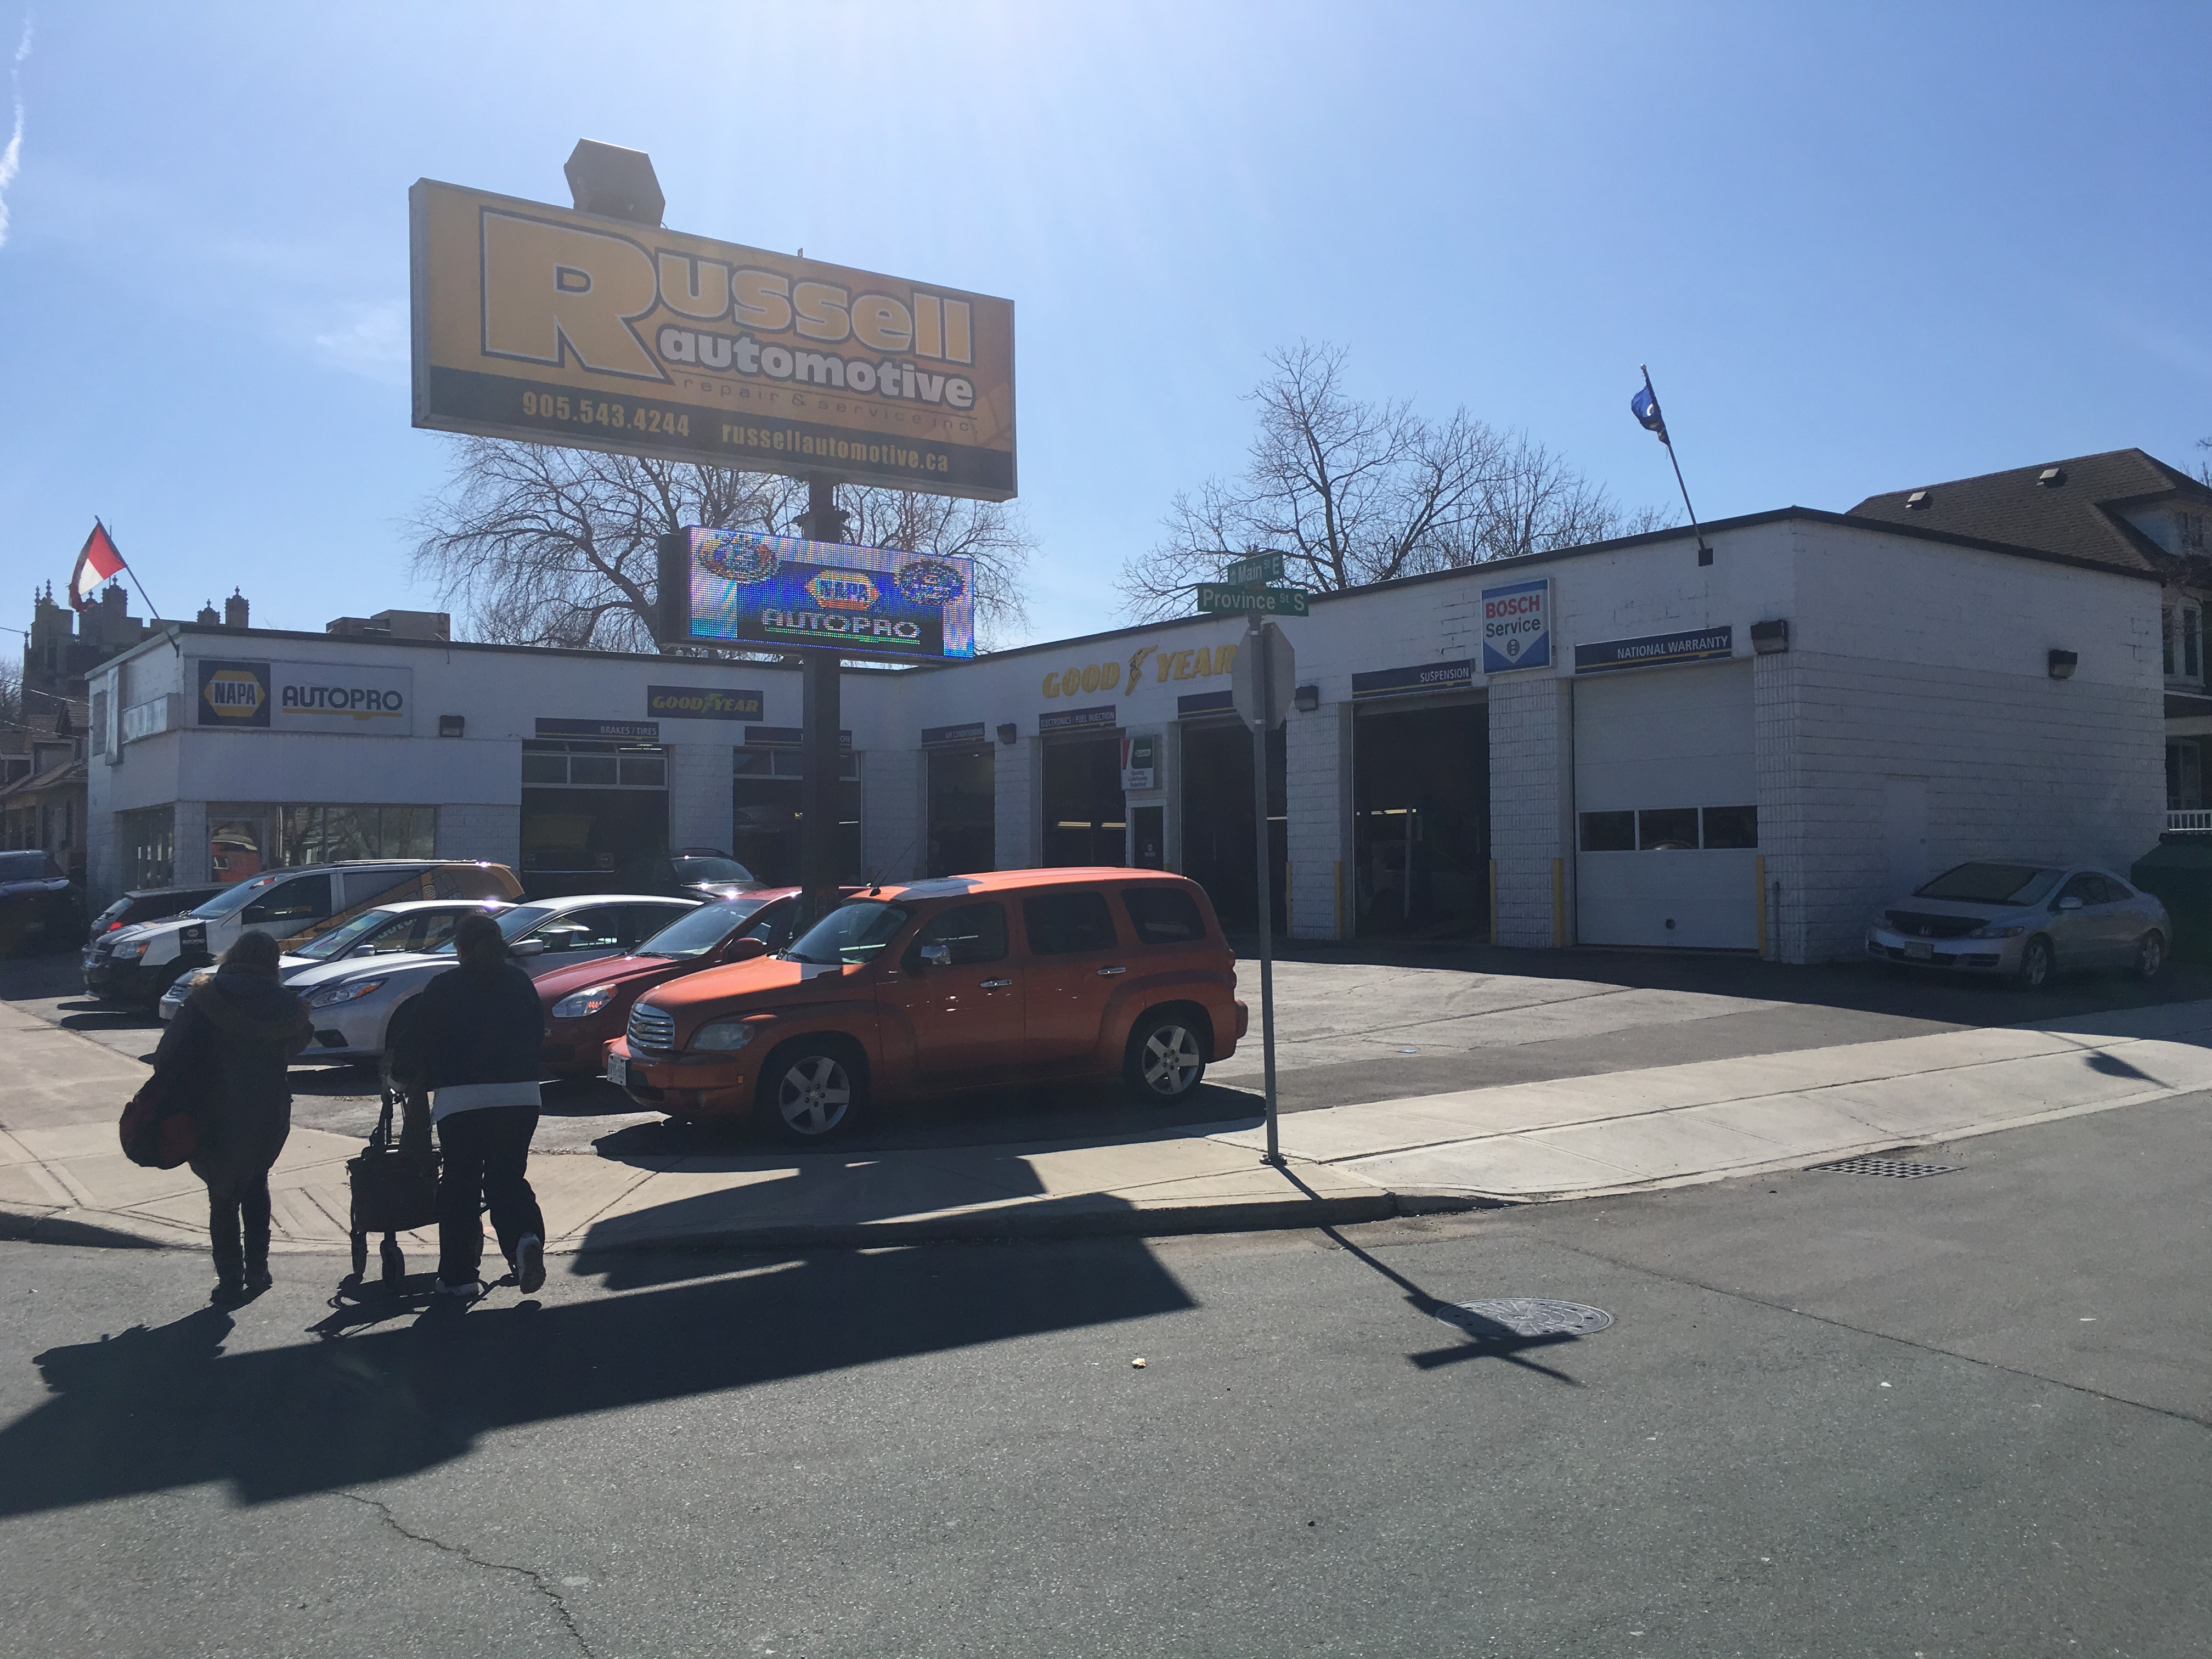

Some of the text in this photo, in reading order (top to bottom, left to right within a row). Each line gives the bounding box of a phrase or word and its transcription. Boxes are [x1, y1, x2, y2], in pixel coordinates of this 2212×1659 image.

[479, 206, 975, 385] Russell
[658, 326, 974, 409] automotive
[522, 391, 690, 437] 905.543.4244
[684, 379, 779, 402] repair
[791, 393, 806, 406] &
[819, 401, 922, 424] service
[722, 424, 949, 472] russellautomotive.ca
[1238, 556, 1280, 583] Main St E
[1203, 588, 1305, 611] Province St S
[1485, 594, 1541, 619] BOSCH
[760, 608, 922, 639] AUTOPRO
[1486, 616, 1541, 638] Service
[1617, 635, 1728, 659] NATIONAL WARRANTY
[1419, 667, 1470, 682] SUSPENSION
[214, 682, 256, 706] NAPA
[282, 685, 403, 712] AUTOPRO
[600, 725, 630, 735] BRAKES
[636, 726, 657, 736] TIRES
